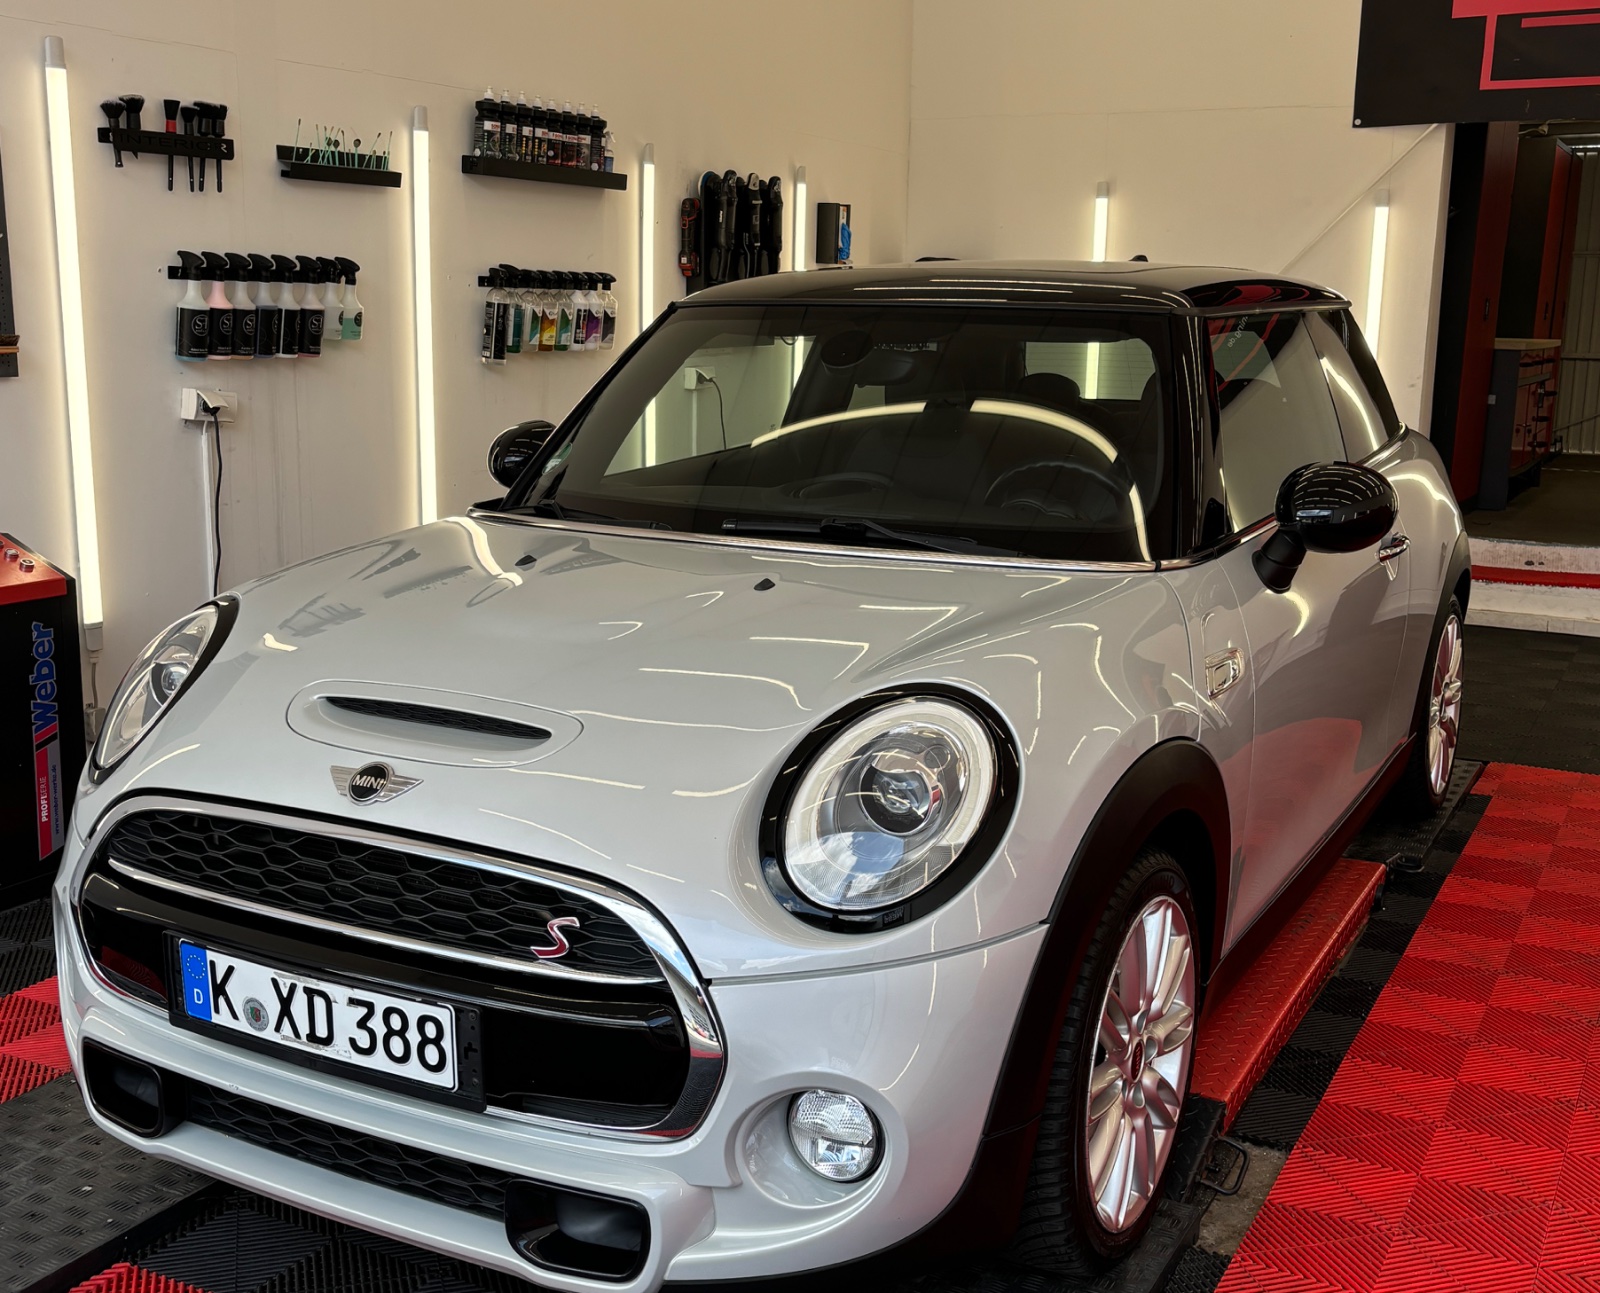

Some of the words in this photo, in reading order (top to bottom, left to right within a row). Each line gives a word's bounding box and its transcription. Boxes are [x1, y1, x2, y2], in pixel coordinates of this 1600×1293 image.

[29, 621, 58, 734] Weber
[352, 774, 386, 790] MINI
[530, 917, 580, 959] S
[194, 988, 204, 1004] D
[209, 959, 240, 1021] K
[271, 976, 335, 1047] XD
[348, 996, 448, 1074] 388
